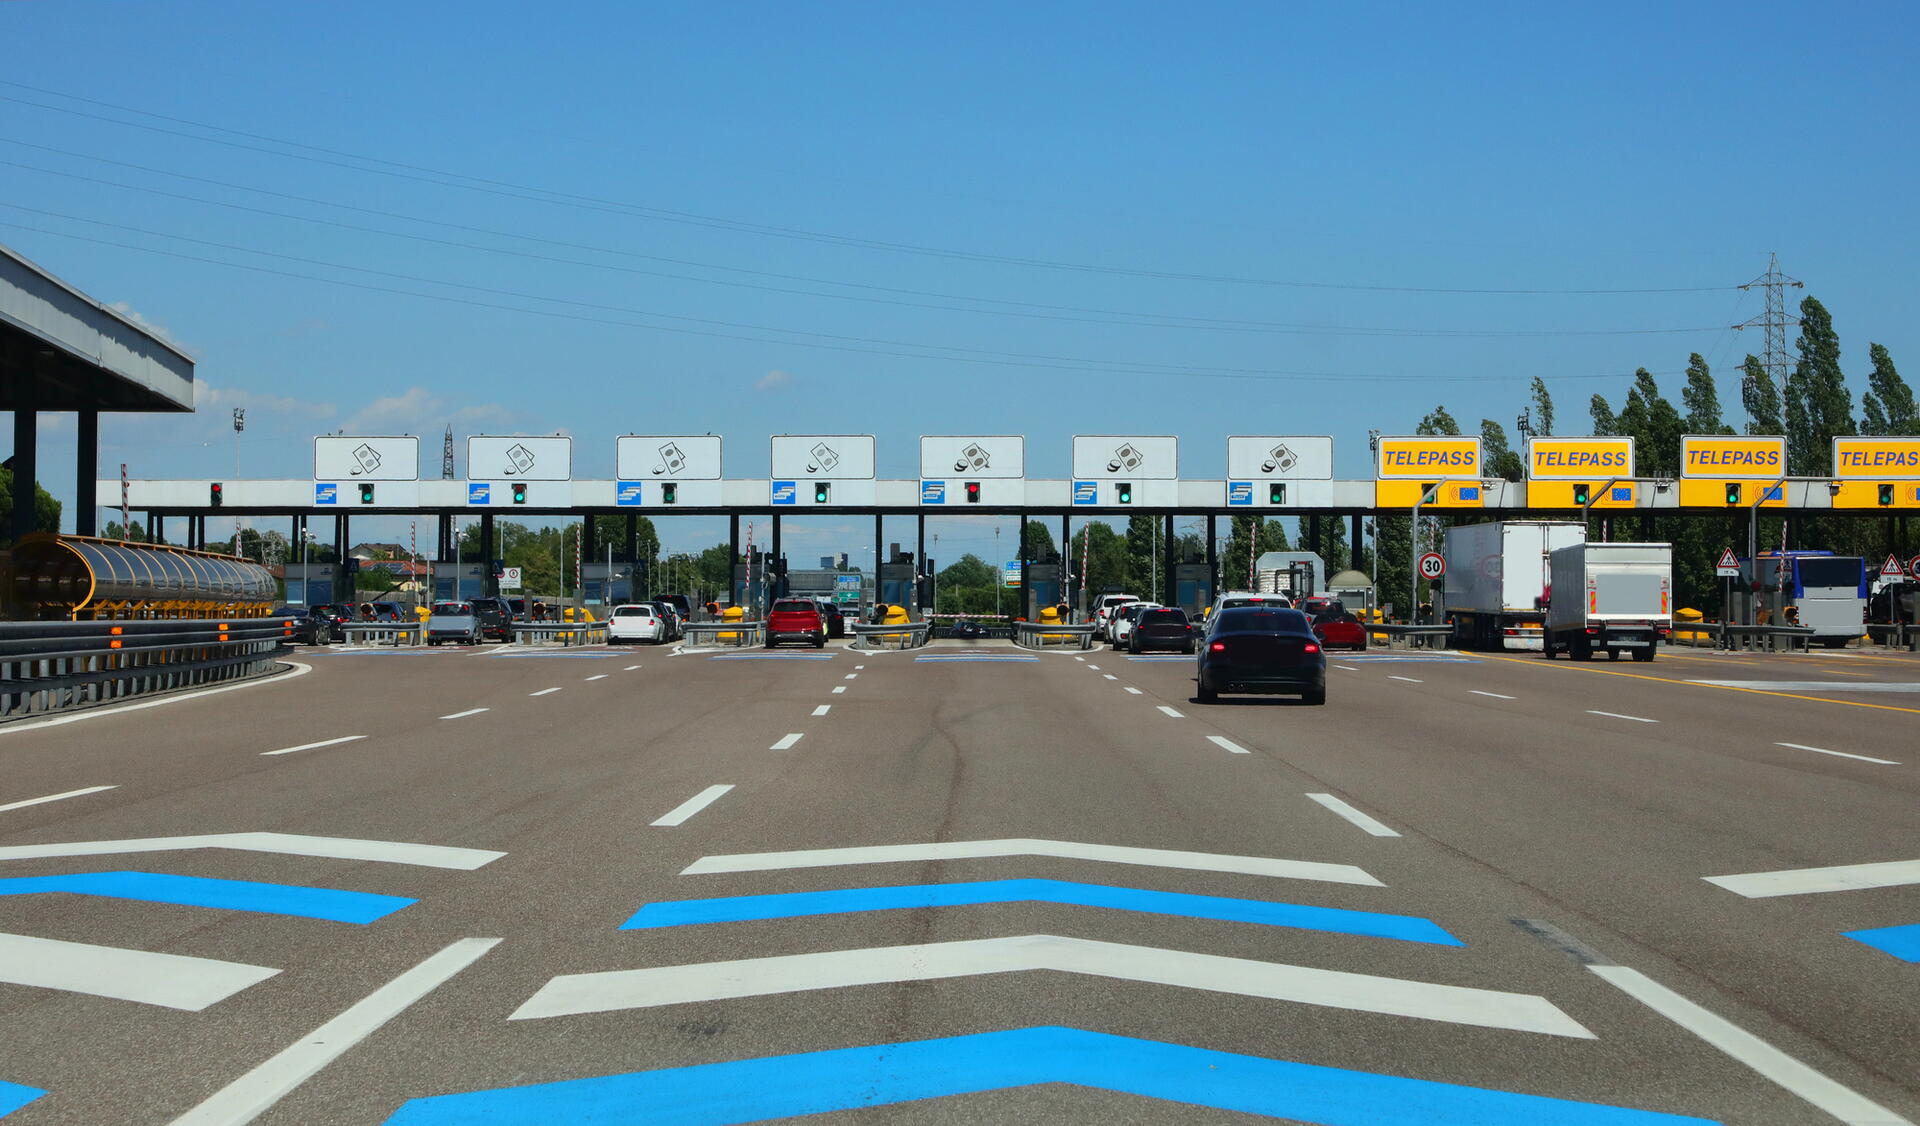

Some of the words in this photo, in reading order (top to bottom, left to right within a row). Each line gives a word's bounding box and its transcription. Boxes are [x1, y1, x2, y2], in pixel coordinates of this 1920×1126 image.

[1385, 451, 1475, 466] TELEPASS
[1535, 452, 1626, 467] TELEPASS
[1689, 450, 1779, 466] TELEPASS
[1425, 560, 1441, 573] 30
